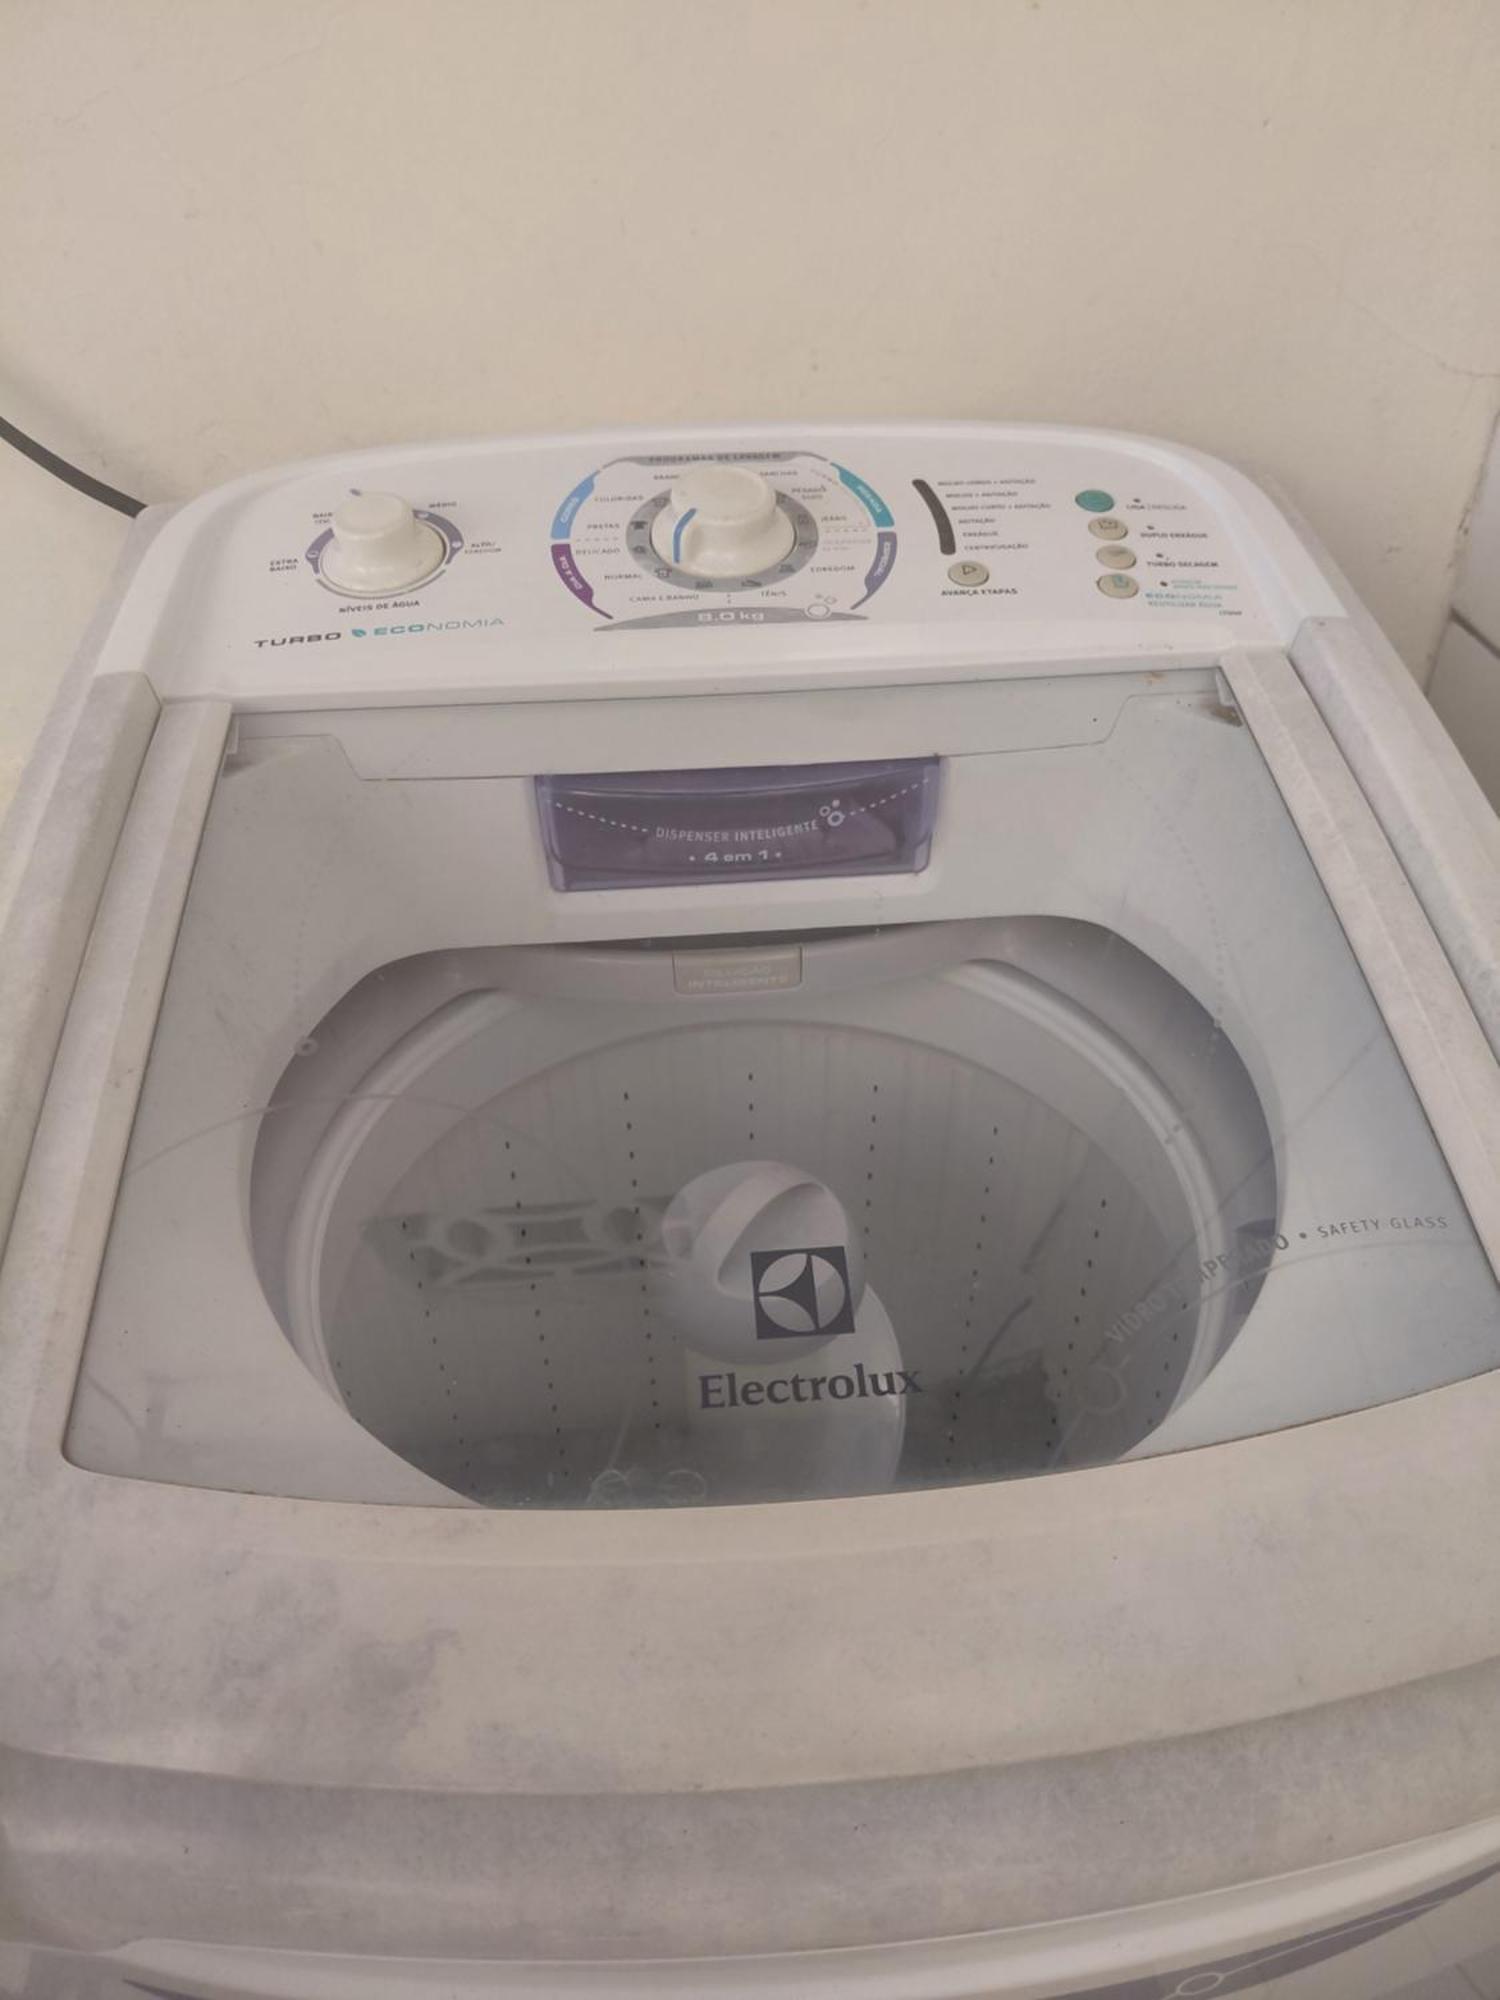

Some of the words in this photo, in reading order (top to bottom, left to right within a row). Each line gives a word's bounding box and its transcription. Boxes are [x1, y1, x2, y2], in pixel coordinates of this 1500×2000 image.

[941, 589, 979, 597] AVANÇA
[981, 587, 1018, 595] ETAPAS
[339, 603, 373, 613] NÍVEIS
[375, 602, 389, 611] DE
[391, 600, 420, 610] ÁGUA
[253, 632, 342, 648] TURBO
[373, 617, 505, 636] ECONOMIA
[656, 826, 730, 842] DISPENSER
[735, 818, 819, 842] INTELIGENTE
[704, 851, 718, 862] 4
[723, 852, 752, 862] em
[758, 849, 769, 860] 1
[1104, 1294, 1168, 1343] VIDRO
[1317, 1218, 1379, 1238] SAFETY
[1389, 1215, 1448, 1230] GLASS
[698, 1362, 924, 1410] Electrolux
